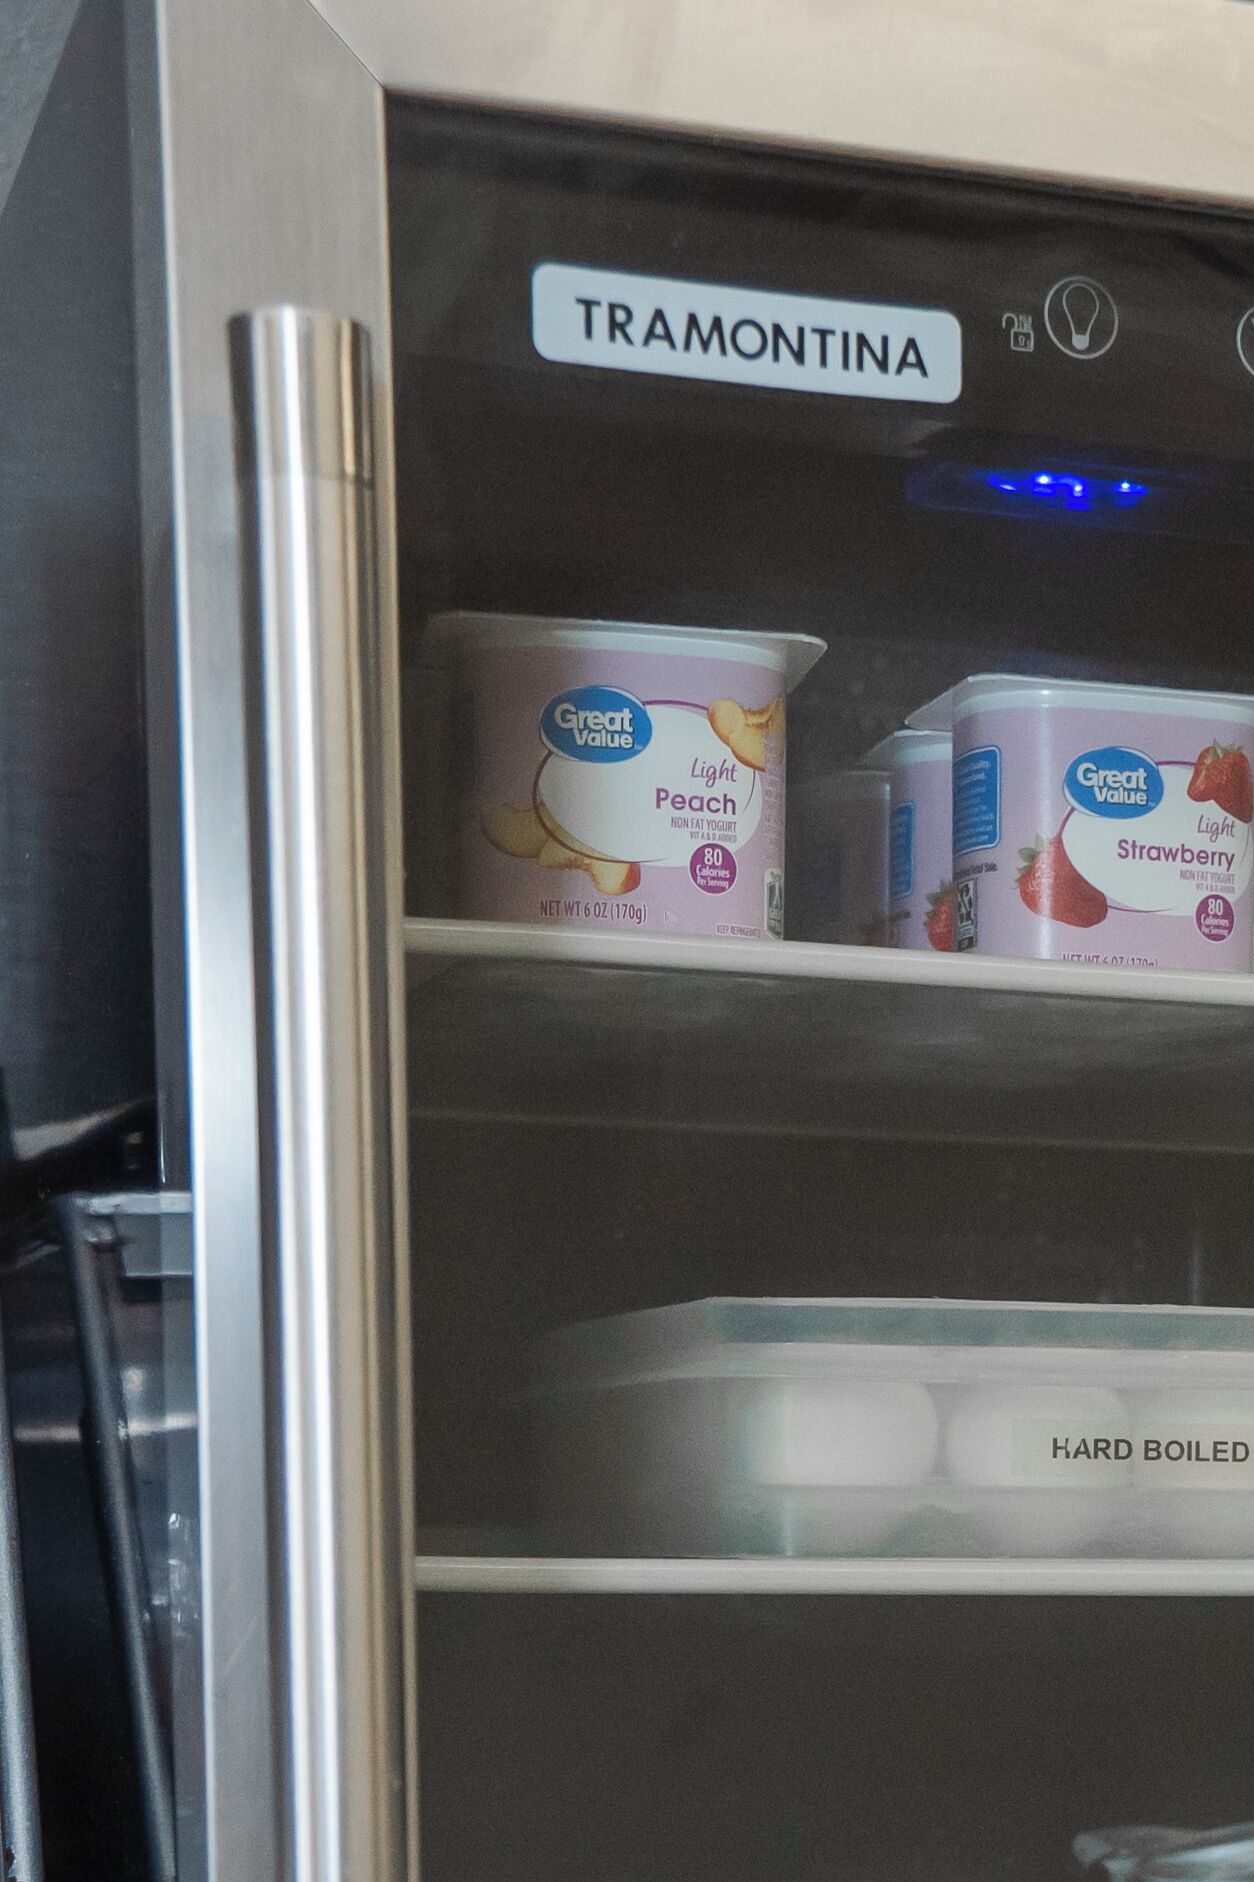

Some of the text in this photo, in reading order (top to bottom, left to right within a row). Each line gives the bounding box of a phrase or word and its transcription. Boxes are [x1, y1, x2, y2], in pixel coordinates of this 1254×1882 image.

[574, 296, 931, 379] TRAMONTINA
[553, 702, 634, 733] Great
[573, 729, 634, 750] Value
[690, 757, 738, 788] Light
[1076, 762, 1149, 792] Great
[655, 787, 737, 816] Peach
[1094, 786, 1148, 807] Value
[670, 816, 738, 834] NON FAT YOGURT
[1196, 814, 1237, 844] Light
[703, 848, 723, 867] 80
[1116, 838, 1236, 873] Strawberry
[695, 864, 731, 879] Calories
[696, 876, 730, 890] Per Serving
[1179, 869, 1236, 885] NON FAT YOGURT
[539, 900, 648, 925] NET WT 6 OZ (170g)
[1207, 899, 1224, 917] 80
[1200, 914, 1230, 929] Calories
[1050, 1437, 1134, 1461] HARD
[1142, 1439, 1250, 1464] BOILED
